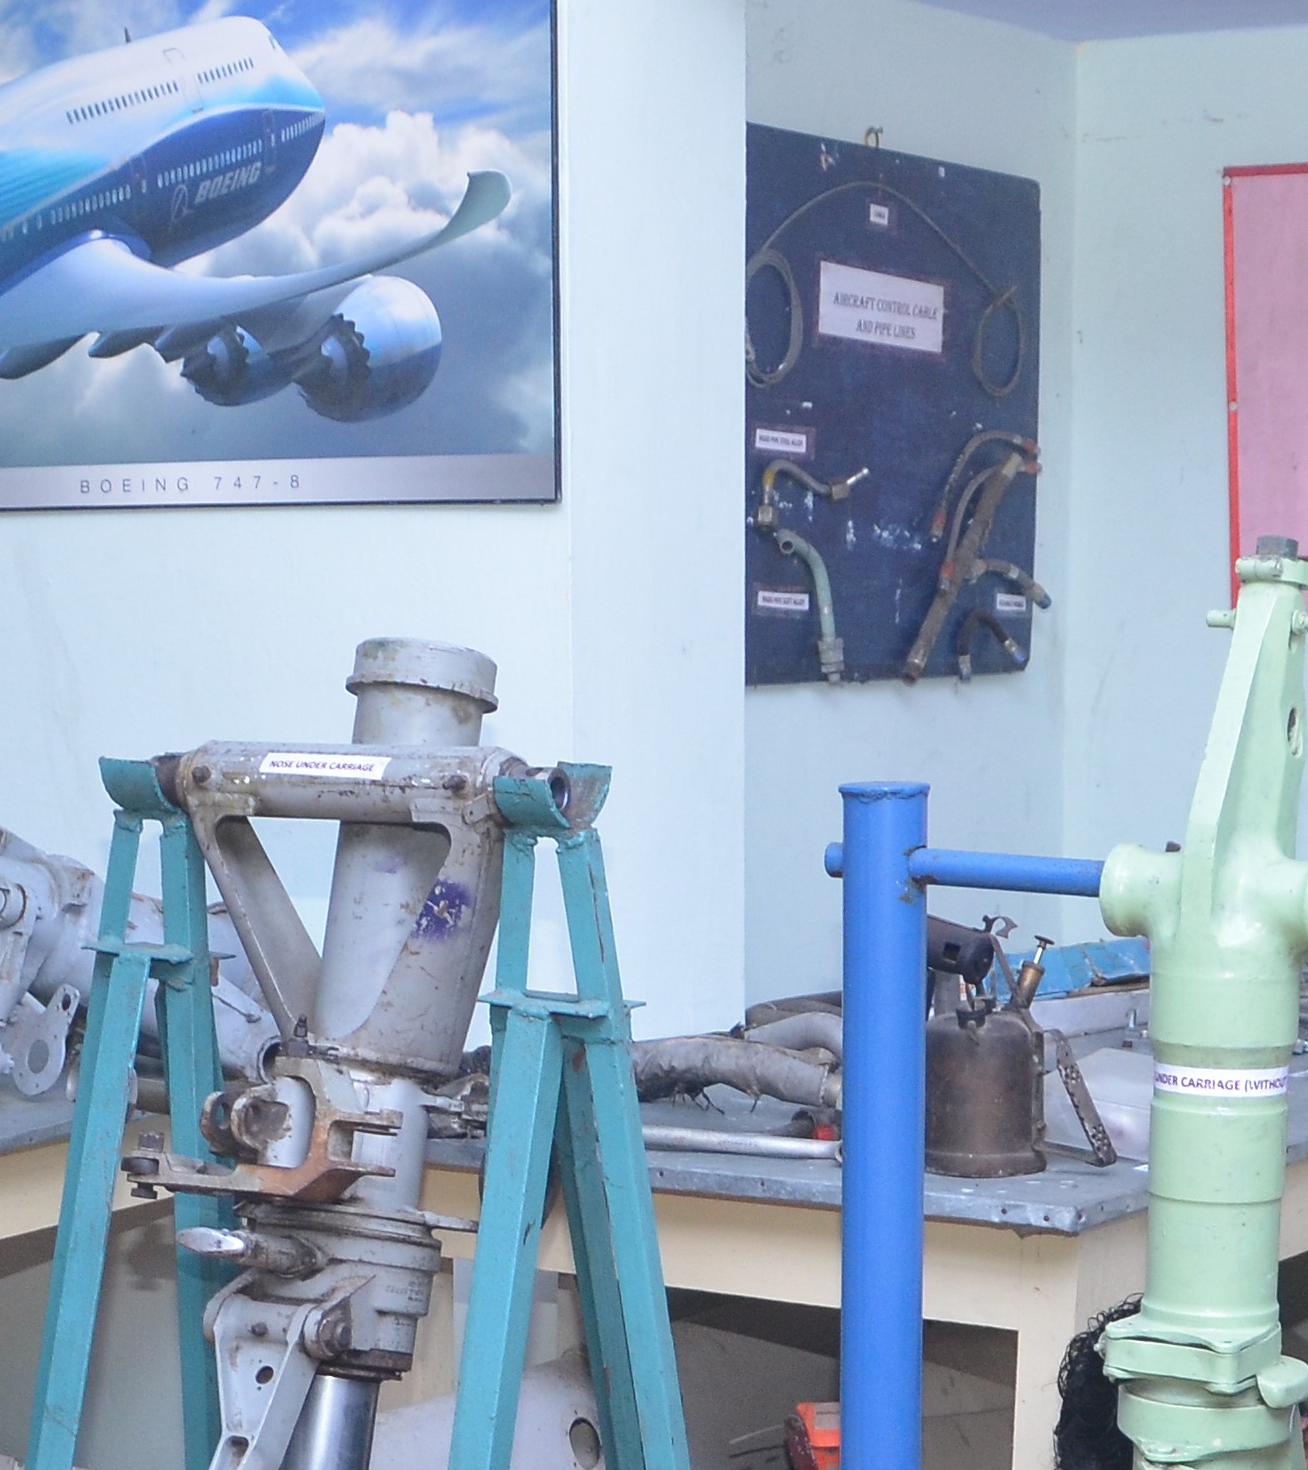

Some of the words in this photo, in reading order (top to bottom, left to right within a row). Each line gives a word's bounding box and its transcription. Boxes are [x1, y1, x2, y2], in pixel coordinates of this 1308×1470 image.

[195, 161, 262, 204] BOEING
[833, 292, 875, 311] AIRCRAFT
[876, 299, 912, 317] CONTROL
[912, 304, 939, 320] CABLE
[856, 319, 874, 333] AND
[874, 321, 892, 336] PIPE
[79, 477, 189, 494] BOEING
[269, 760, 293, 769] NOSE
[295, 761, 327, 770] UNDER
[329, 761, 375, 772] CARRIAGE
[1180, 1077, 1241, 1090] CARRIAGE
[1244, 1076, 1287, 1092] (WITHOU
